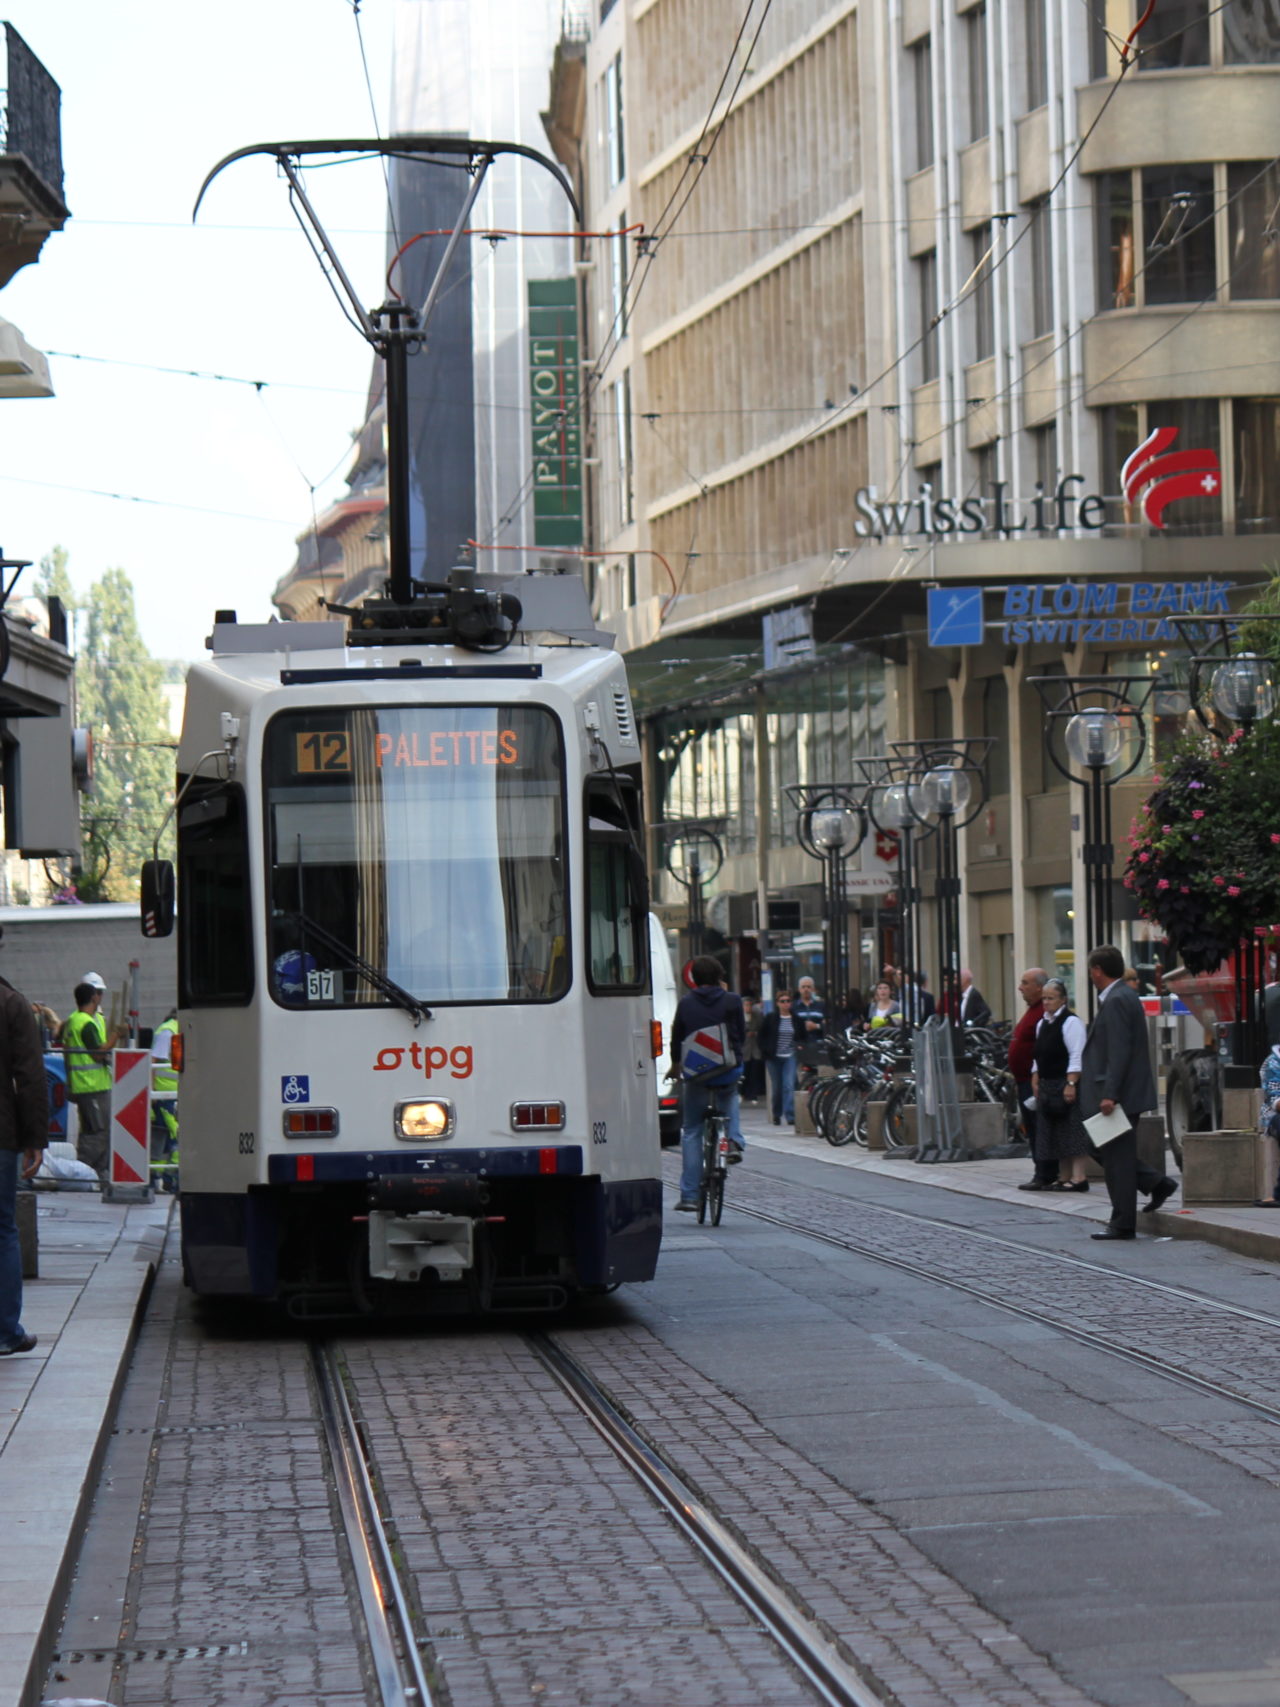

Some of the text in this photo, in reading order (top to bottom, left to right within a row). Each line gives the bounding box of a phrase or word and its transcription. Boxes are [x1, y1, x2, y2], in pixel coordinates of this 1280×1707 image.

[533, 341, 559, 483] PAYOT
[1003, 582, 1231, 617] BLOM BANK
[303, 733, 348, 771] 12
[375, 730, 518, 768] PALETTES
[409, 1041, 473, 1080] tpg
[239, 1131, 254, 1154] 832
[593, 1121, 607, 1145] 832
